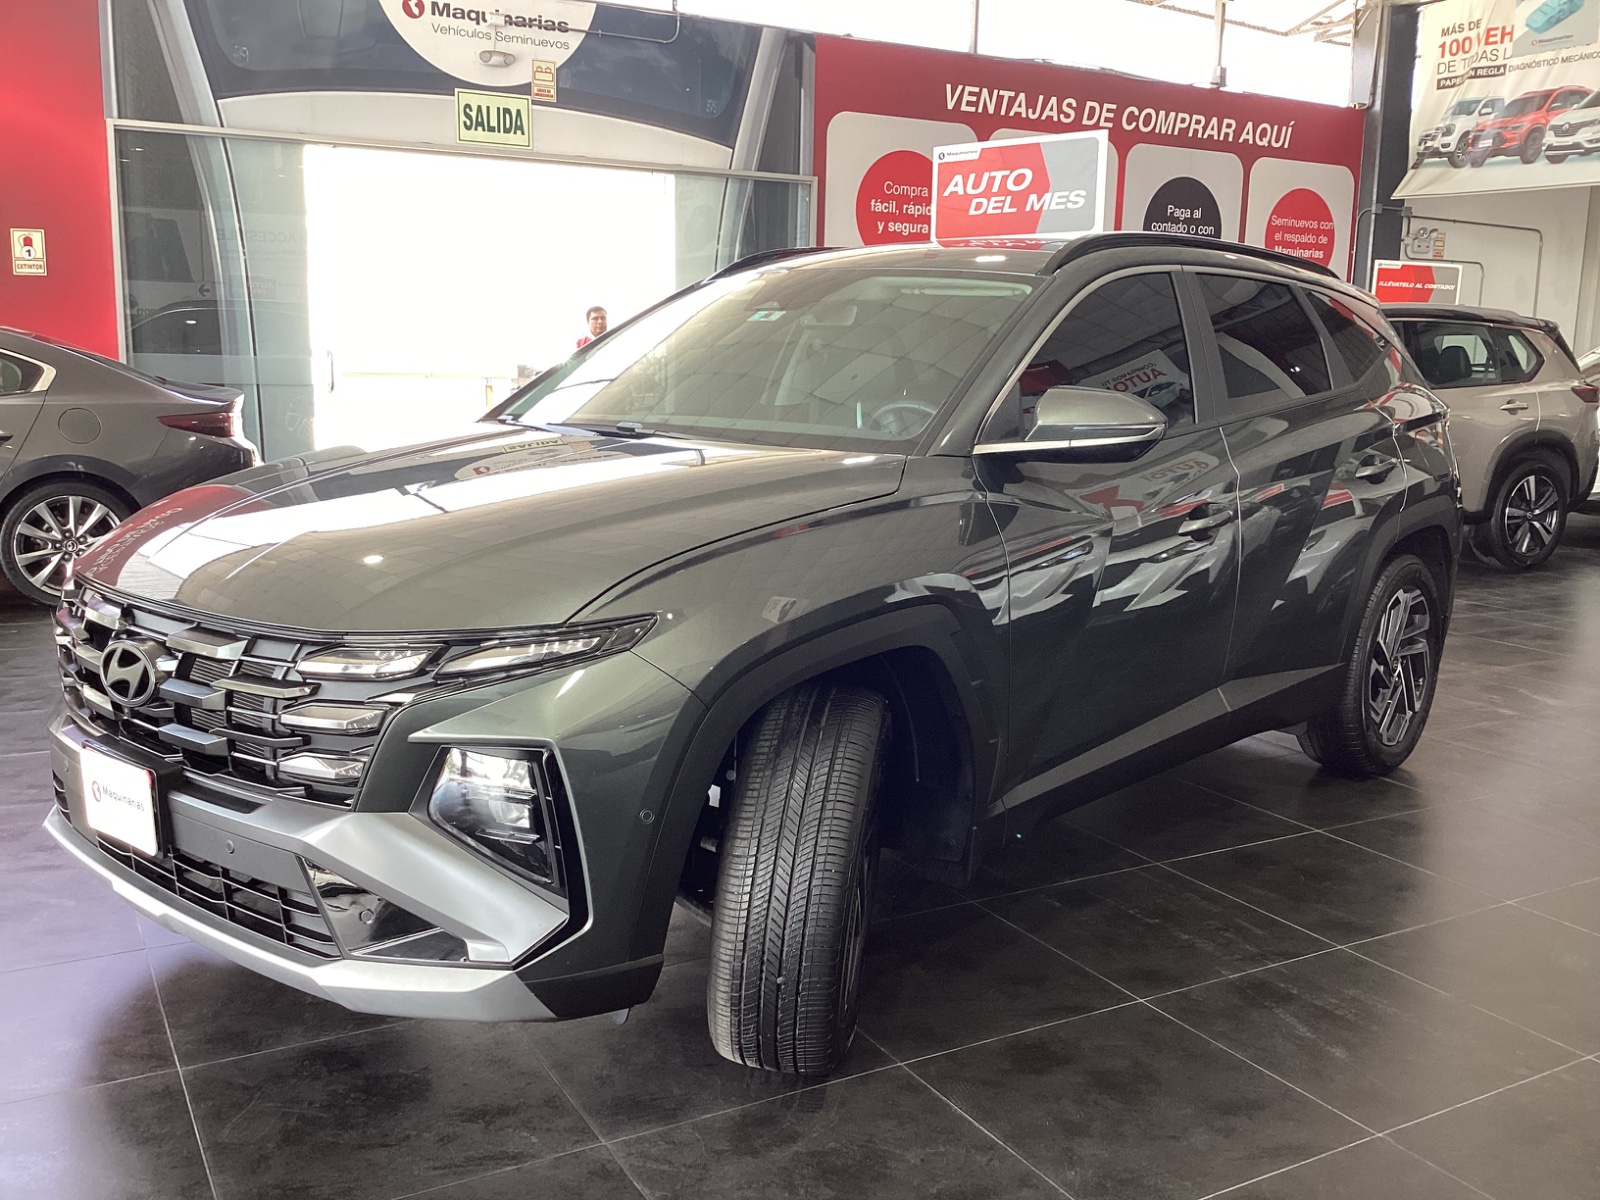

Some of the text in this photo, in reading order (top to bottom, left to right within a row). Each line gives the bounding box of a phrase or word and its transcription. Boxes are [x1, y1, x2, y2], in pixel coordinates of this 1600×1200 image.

[431, 1, 570, 33] Maqnarias
[1441, 18, 1482, 37] MÁS DE
[431, 22, 570, 50] Vehículos Seminuevos
[1438, 36, 1473, 59] 100
[1437, 59, 1456, 75] DE
[1476, 67, 1505, 76] REGLA
[1508, 57, 1560, 73] DIAGNÓSTICO
[463, 103, 525, 136] SALIDA
[945, 83, 1296, 149] VENTAJAS DE COMPRAR AQUÍ
[883, 181, 928, 198] Compra
[942, 168, 1033, 197] AUTO
[870, 199, 932, 218] fácil, rápid
[968, 189, 1087, 216] DEL MES
[1167, 205, 1202, 220] Paga al
[877, 221, 929, 236] y segura
[1151, 221, 1215, 235] contado o con
[1271, 215, 1334, 230] Seminuevos con
[1274, 231, 1328, 244] el respaldo de
[25, 249, 32, 257] 1
[1274, 245, 1324, 259] Maquinarias
